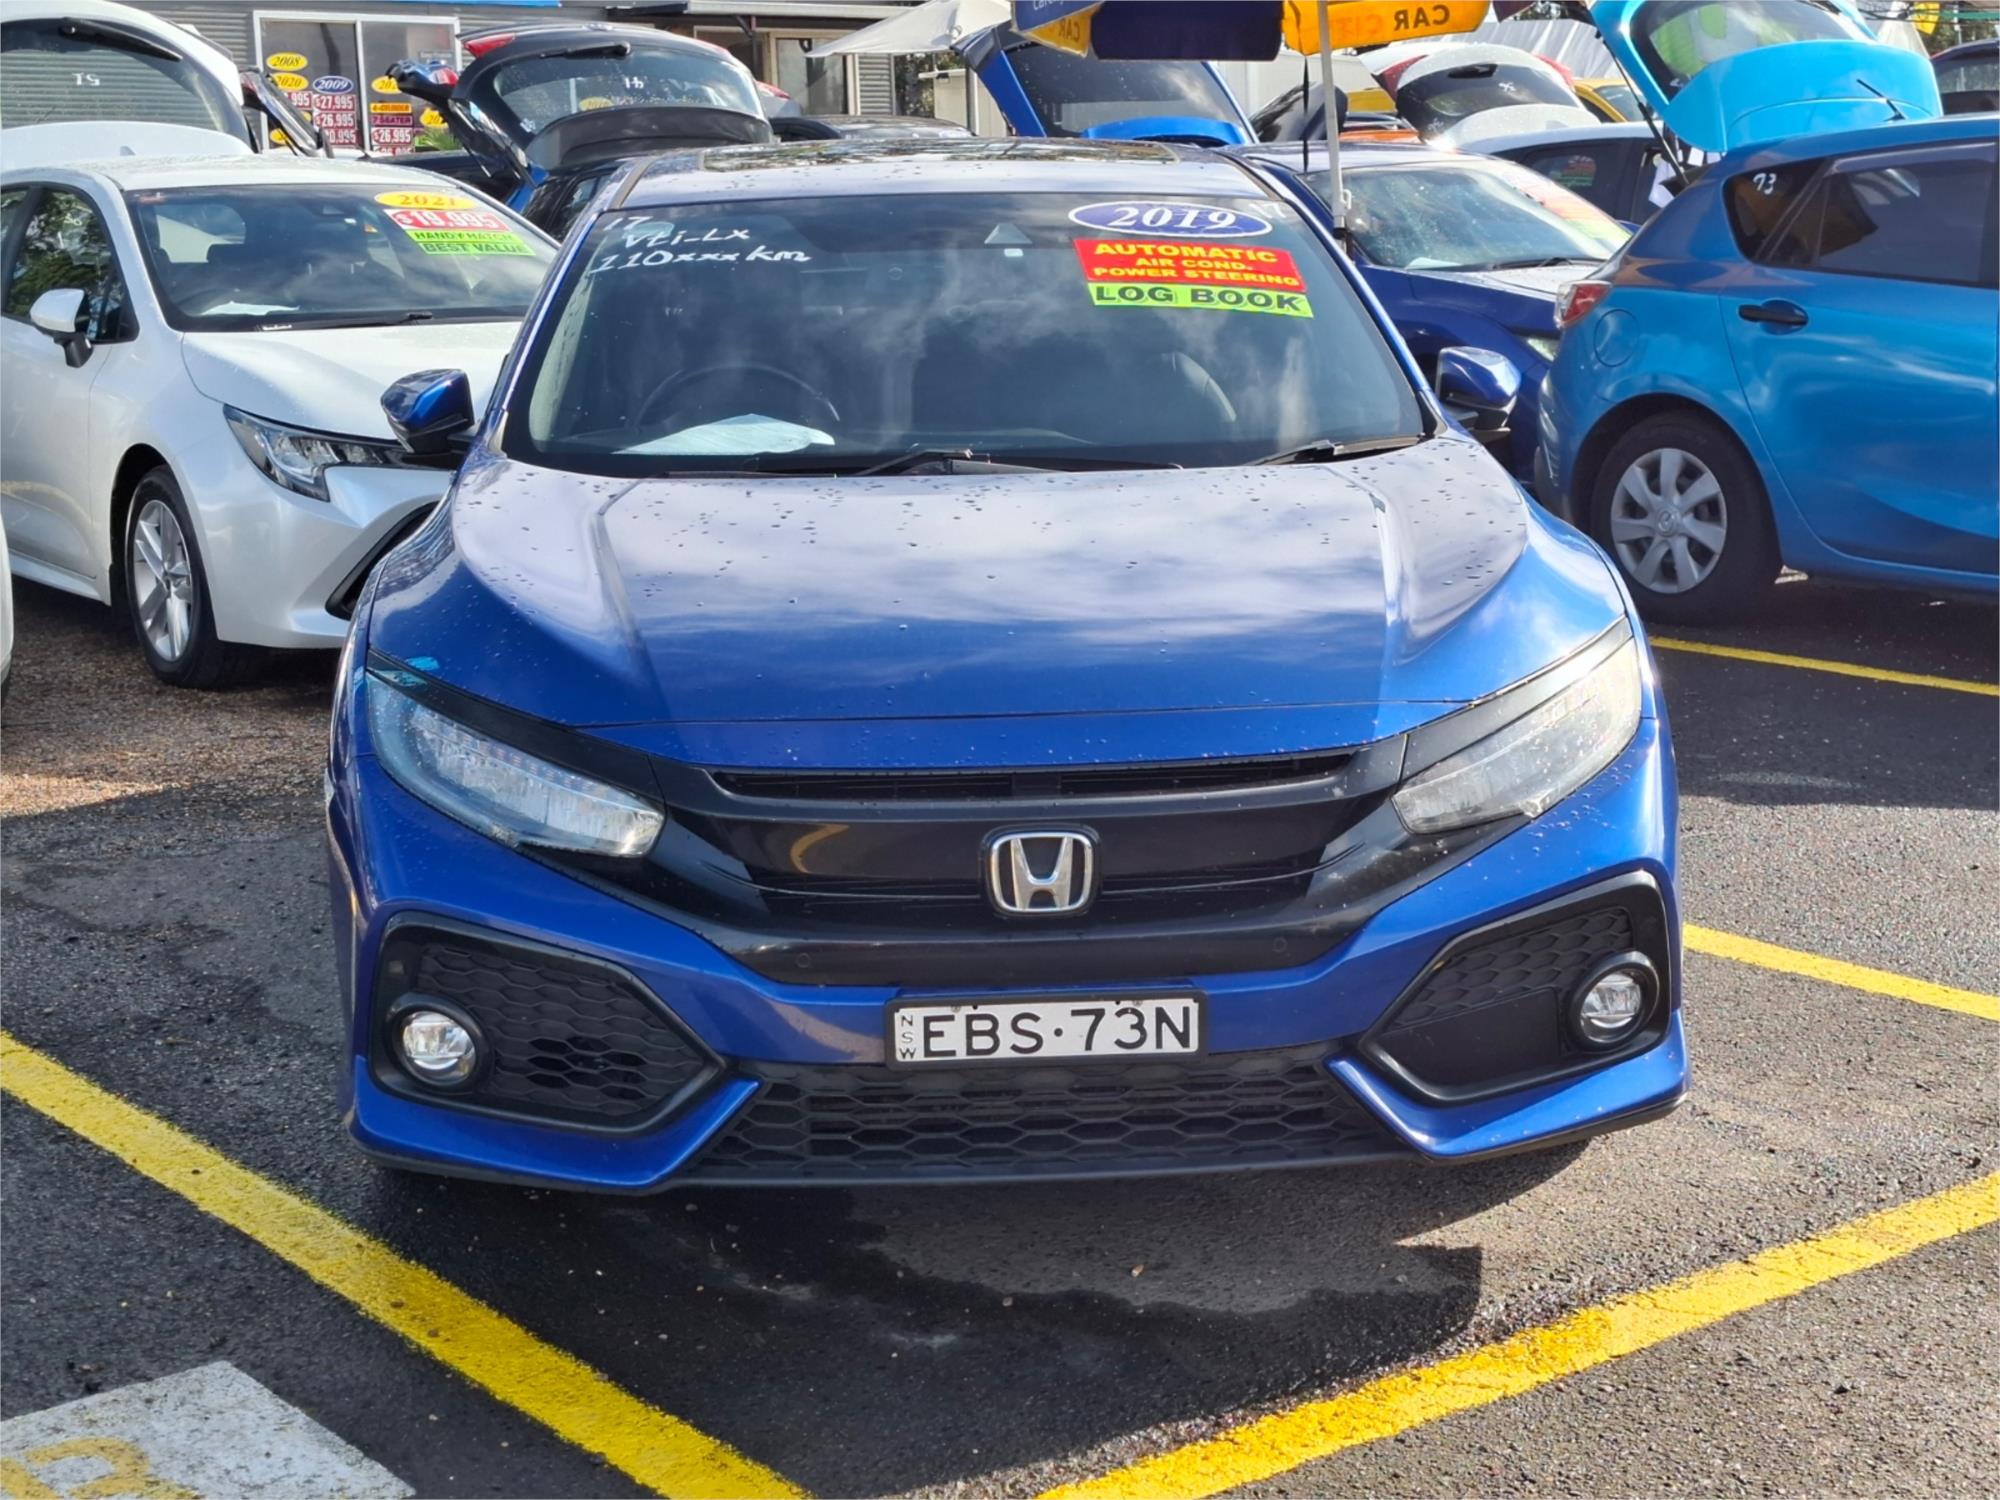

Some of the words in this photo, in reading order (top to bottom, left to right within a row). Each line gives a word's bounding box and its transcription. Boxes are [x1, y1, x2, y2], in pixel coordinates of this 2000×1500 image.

[318, 80, 349, 90] 2009
[400, 195, 456, 206] 2021
[1107, 206, 1236, 229] 2019
[414, 232, 463, 240] HANDY
[466, 232, 513, 241] HATCH
[424, 243, 469, 252] BEST
[472, 244, 525, 253] VALUE
[1095, 243, 1278, 263] AUTOMATIC
[1136, 257, 1174, 267] AIR
[1182, 259, 1254, 271] COND.
[1094, 267, 1178, 278] POWER
[1184, 269, 1300, 286] STEERING
[1096, 286, 1174, 302] LOG
[1190, 288, 1301, 312] BOOK
[899, 1015, 916, 1060] NSW
